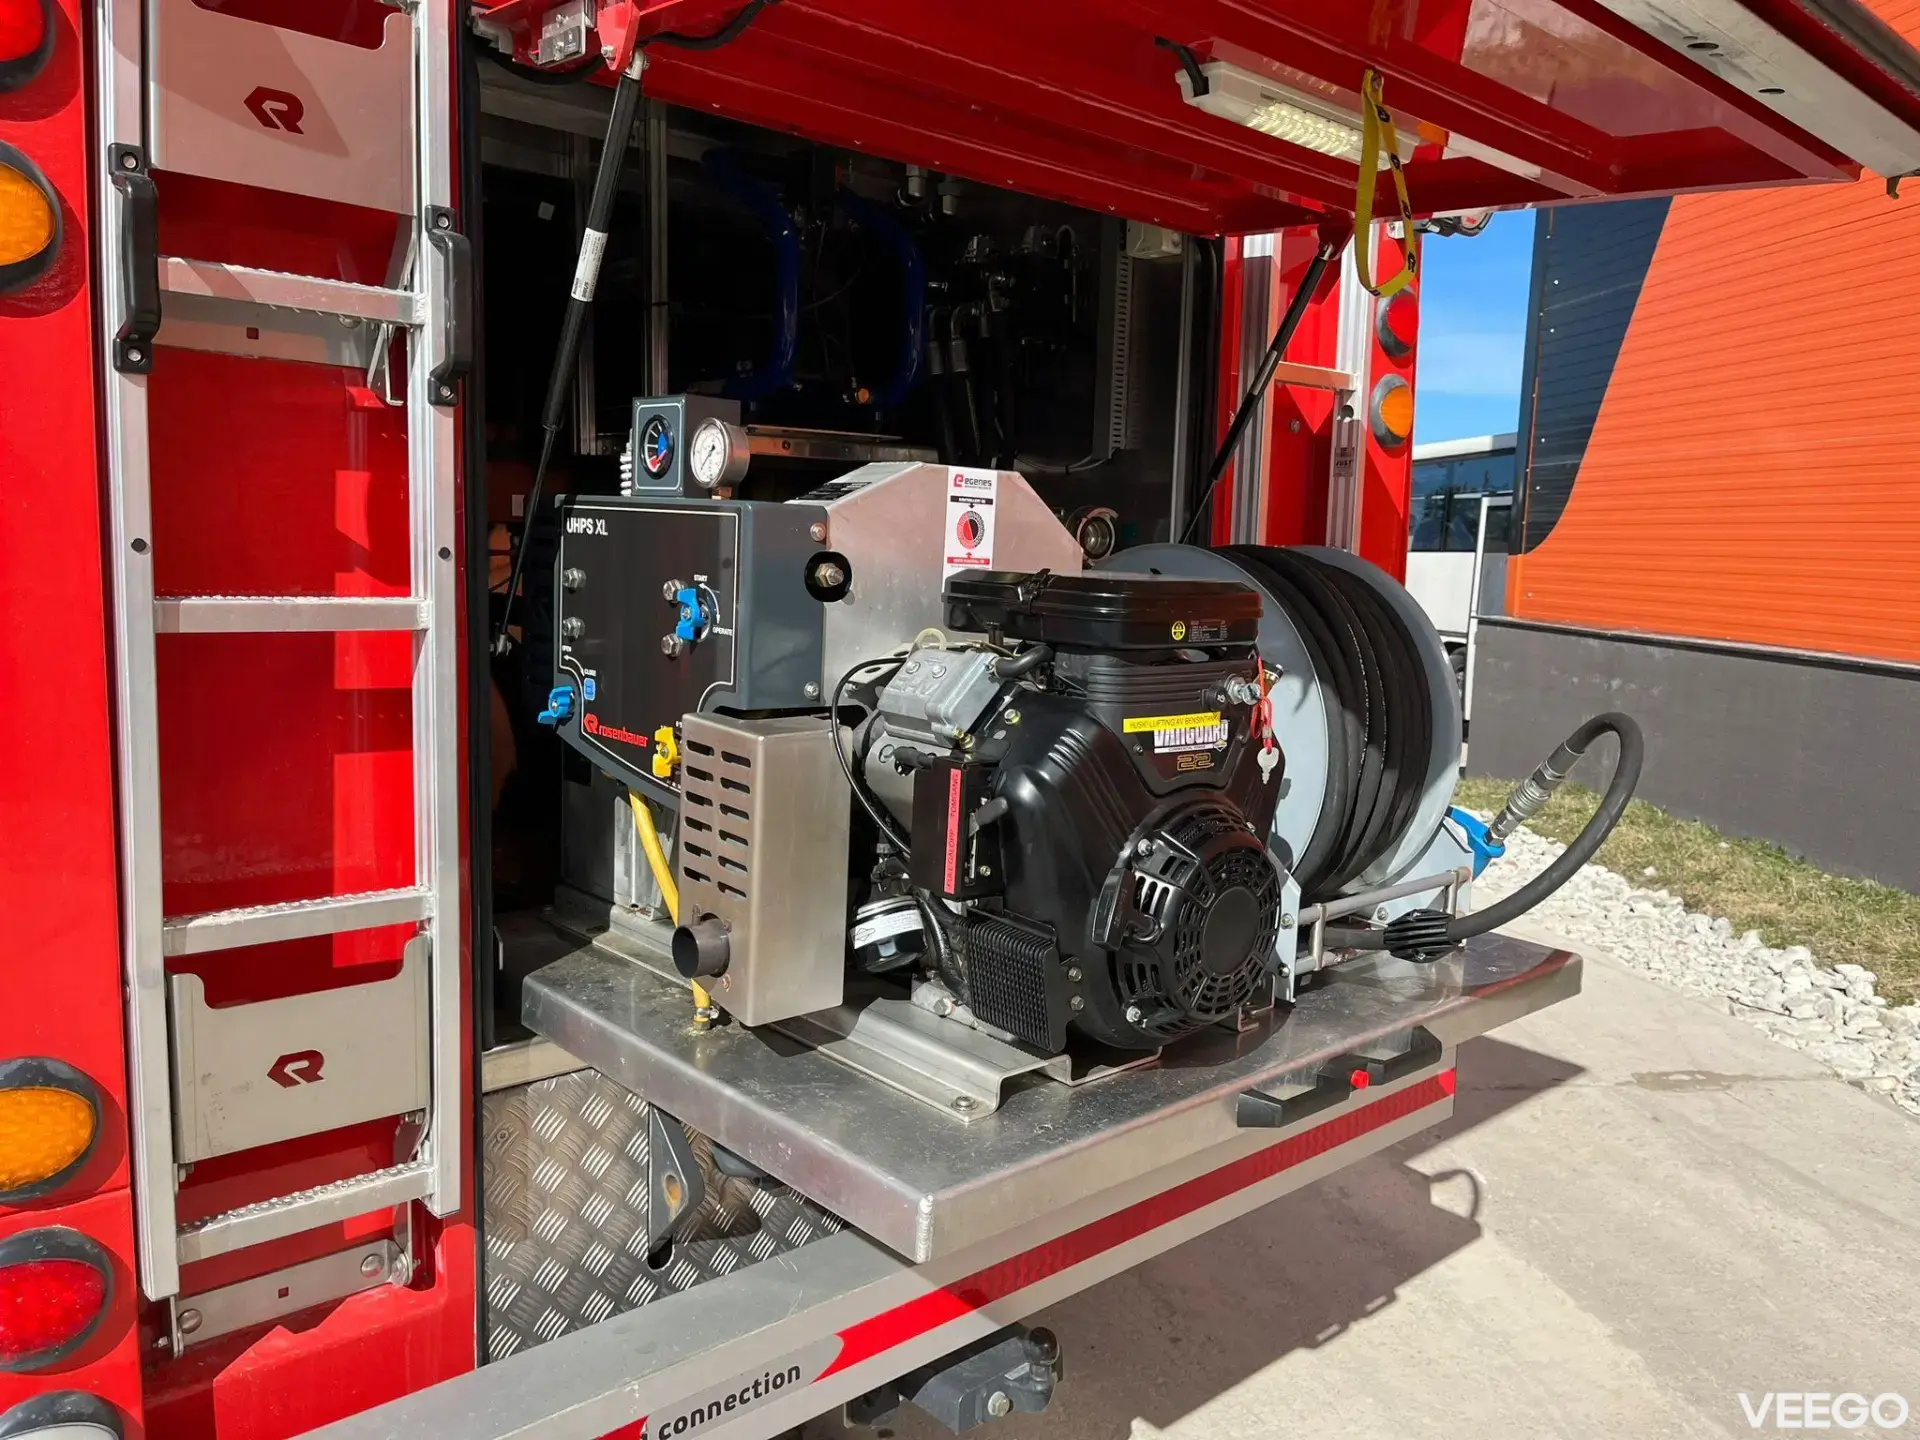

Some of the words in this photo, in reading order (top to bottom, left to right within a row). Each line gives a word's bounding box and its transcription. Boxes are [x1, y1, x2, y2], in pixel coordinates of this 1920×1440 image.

[566, 517, 593, 535] UHPS
[595, 518, 609, 536] XL
[712, 626, 733, 636] OPERATE
[599, 725, 649, 747] rosenbauer
[658, 1365, 801, 1440] connection
